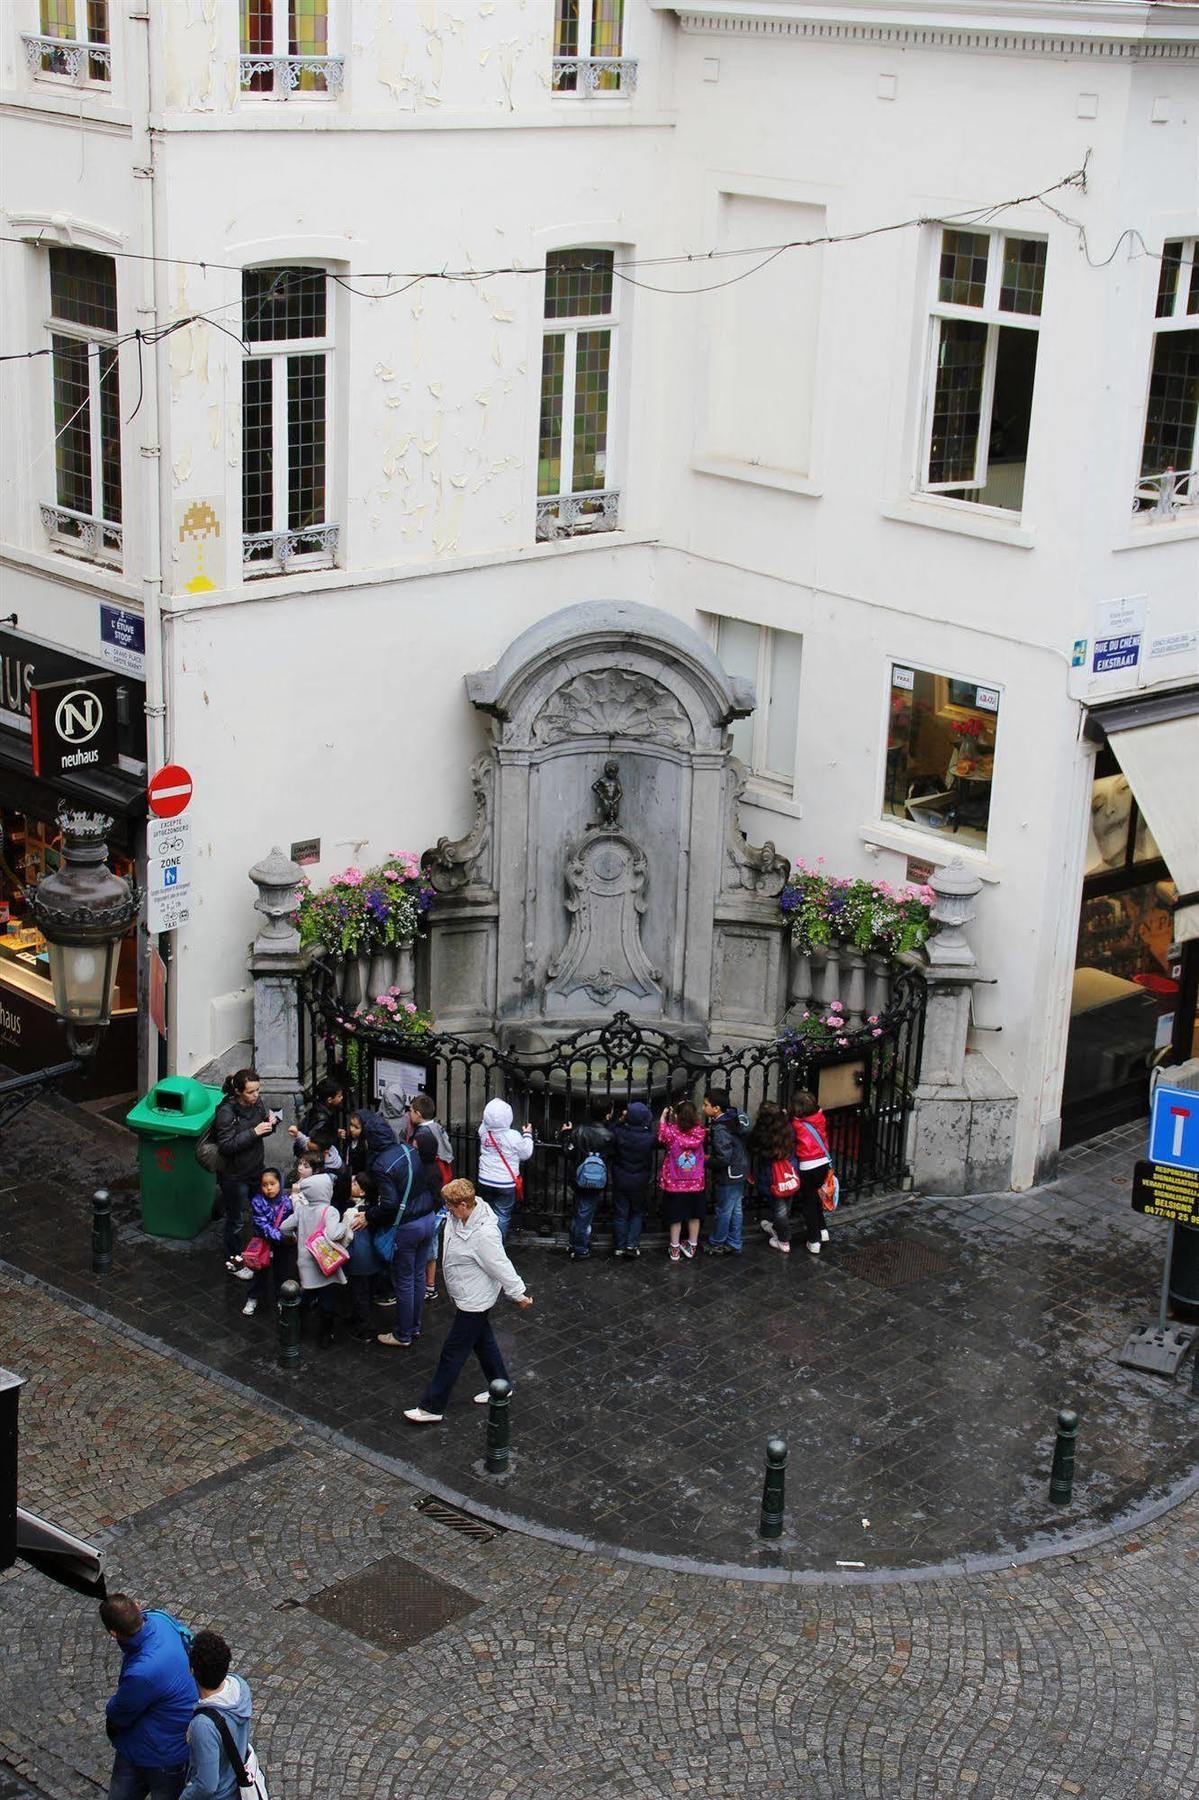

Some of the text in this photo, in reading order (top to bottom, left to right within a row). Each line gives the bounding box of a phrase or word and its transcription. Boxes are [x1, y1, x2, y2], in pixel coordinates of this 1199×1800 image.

[1109, 639, 1119, 651] DU
[0, 654, 35, 716] us
[64, 699, 94, 735] N
[62, 749, 98, 768] neuhaus
[160, 856, 182, 868] ZONE
[1145, 1205, 1176, 1218] 0477/49
[1177, 1212, 1189, 1222] 25
[1155, 1199, 1193, 1213] BELSIGNS
